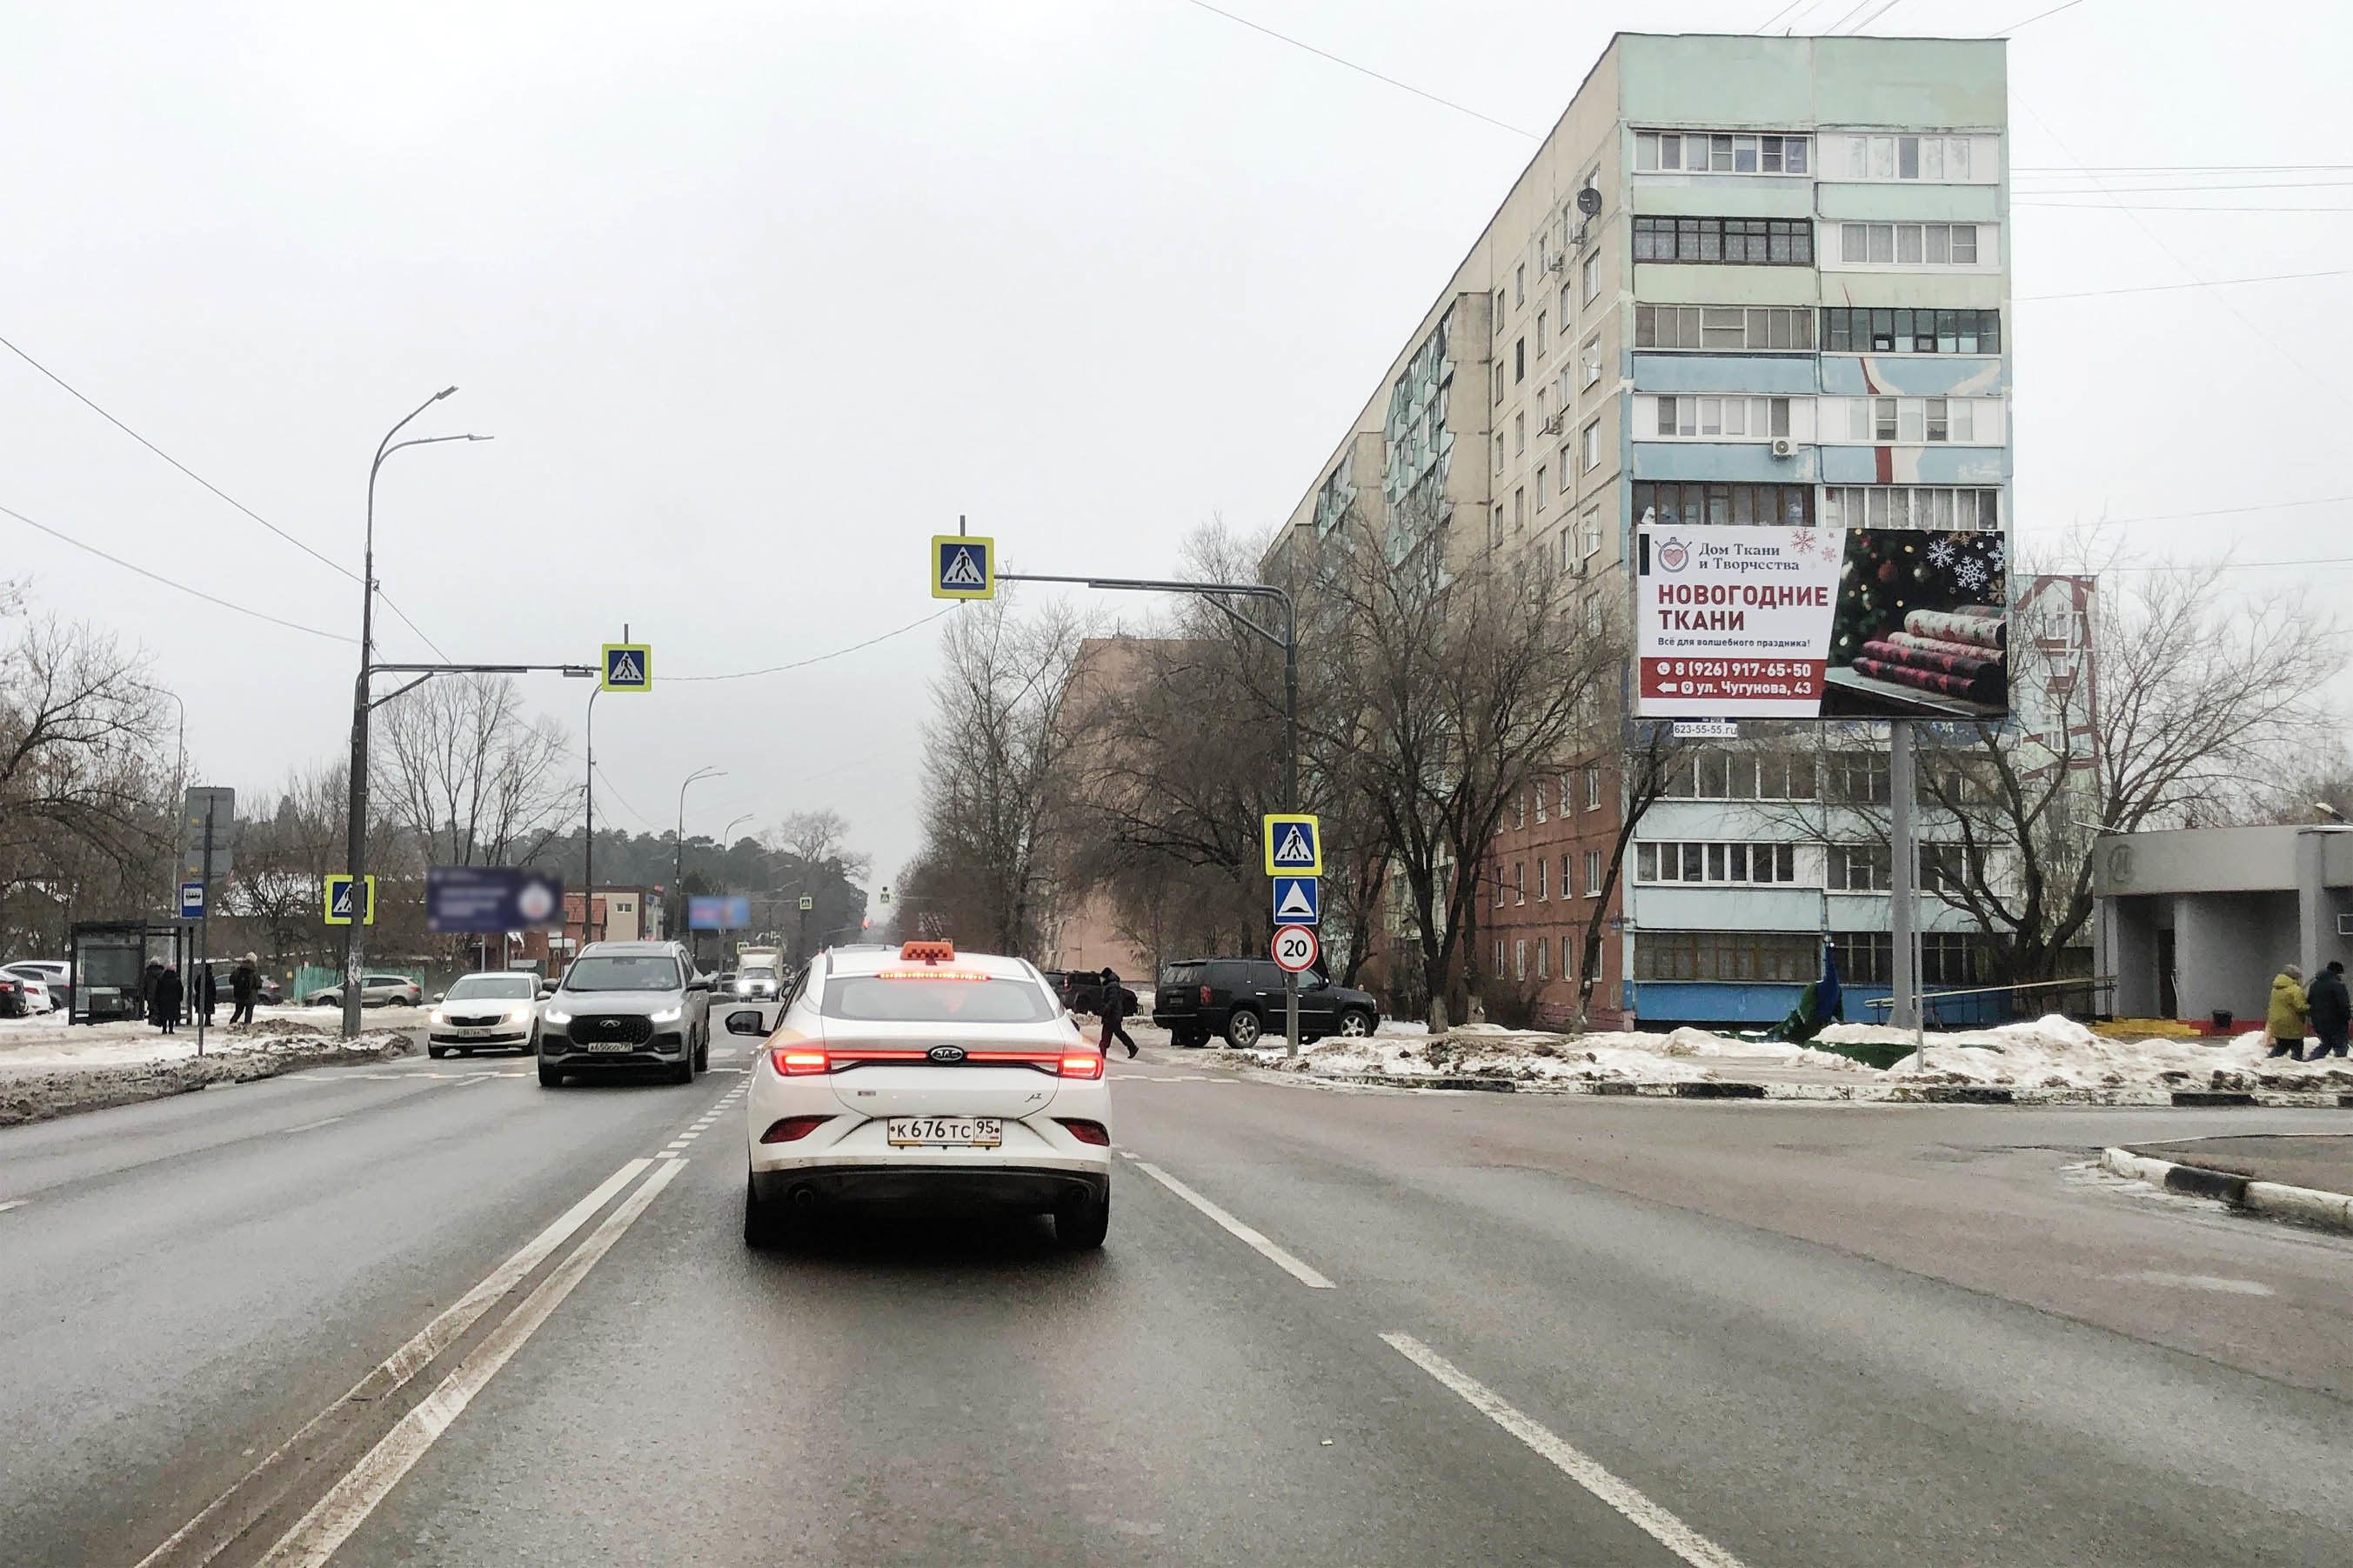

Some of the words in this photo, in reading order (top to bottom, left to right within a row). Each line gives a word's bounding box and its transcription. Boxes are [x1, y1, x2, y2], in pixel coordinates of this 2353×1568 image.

[1699, 543, 1729, 557] Дом
[1734, 544, 1780, 557] Ткани
[1699, 560, 1708, 570] и
[1713, 557, 1800, 573] Творчества
[1659, 584, 1828, 610] НОВОГОДНИЕ
[1658, 610, 1744, 631] ТКАНИ
[1658, 637, 1675, 646] Всё
[1677, 638, 1695, 647] для
[1697, 637, 1755, 647] волшебного
[1756, 639, 1810, 648] праздника!
[1675, 662, 1685, 676] 8
[1688, 661, 1728, 677] (926)
[1696, 683, 1718, 697] ул.
[1721, 681, 1791, 697] Чугунова,
[1794, 681, 1811, 695] 43
[1675, 724, 1737, 735] 623-55-55.ru
[1284, 940, 1307, 957] 20
[977, 1120, 993, 1134] 95
